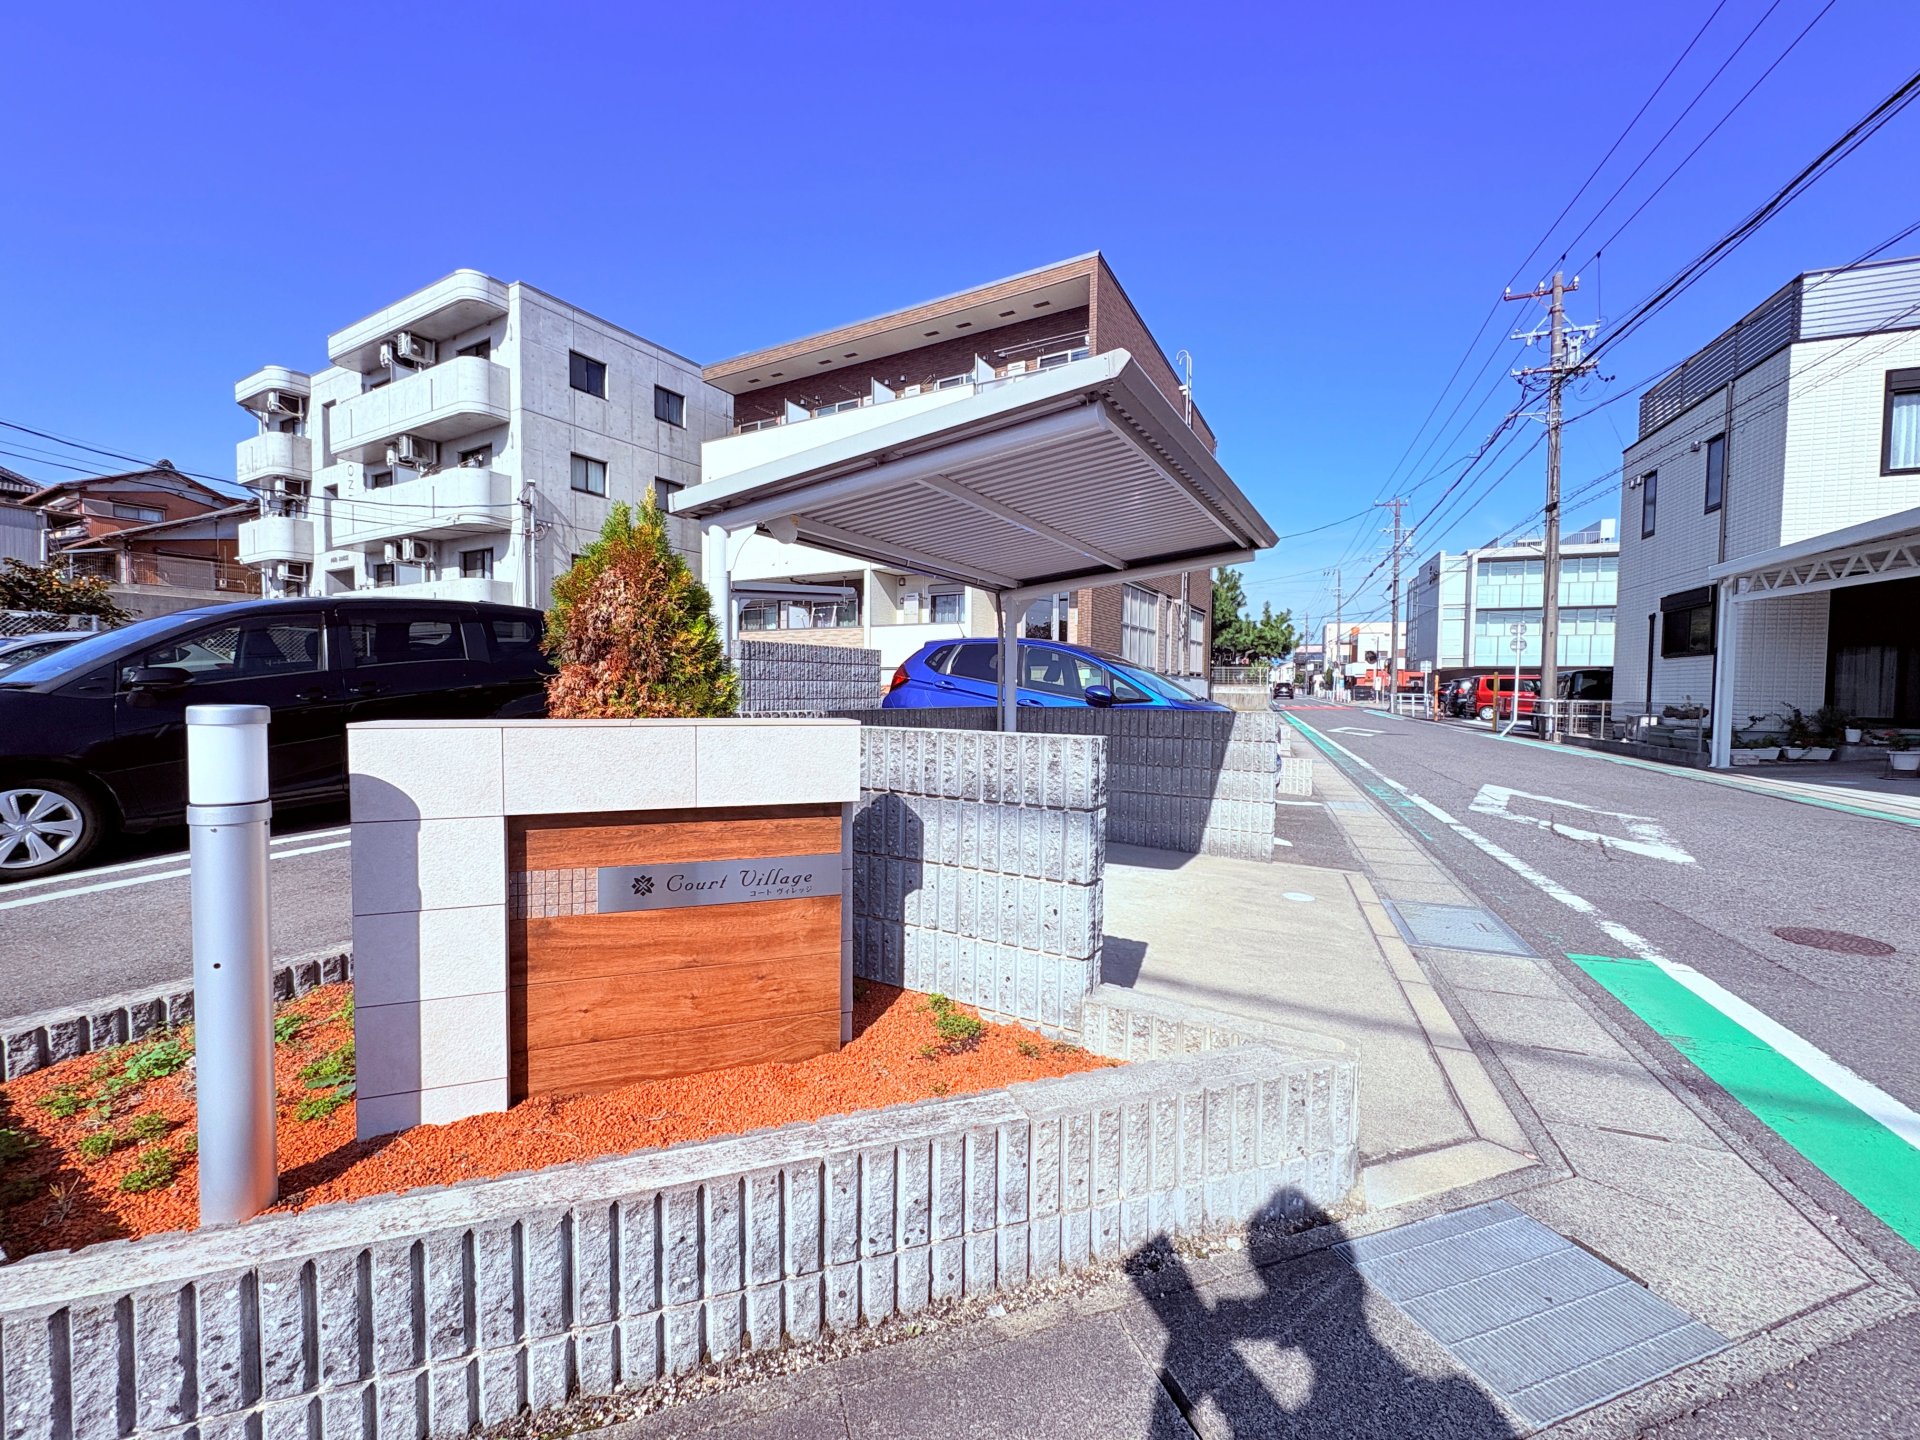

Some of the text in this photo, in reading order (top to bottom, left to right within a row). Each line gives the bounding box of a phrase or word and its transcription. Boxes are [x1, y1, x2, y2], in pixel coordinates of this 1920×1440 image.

[666, 868, 813, 892] Court Village
[750, 889, 771, 897] コート
